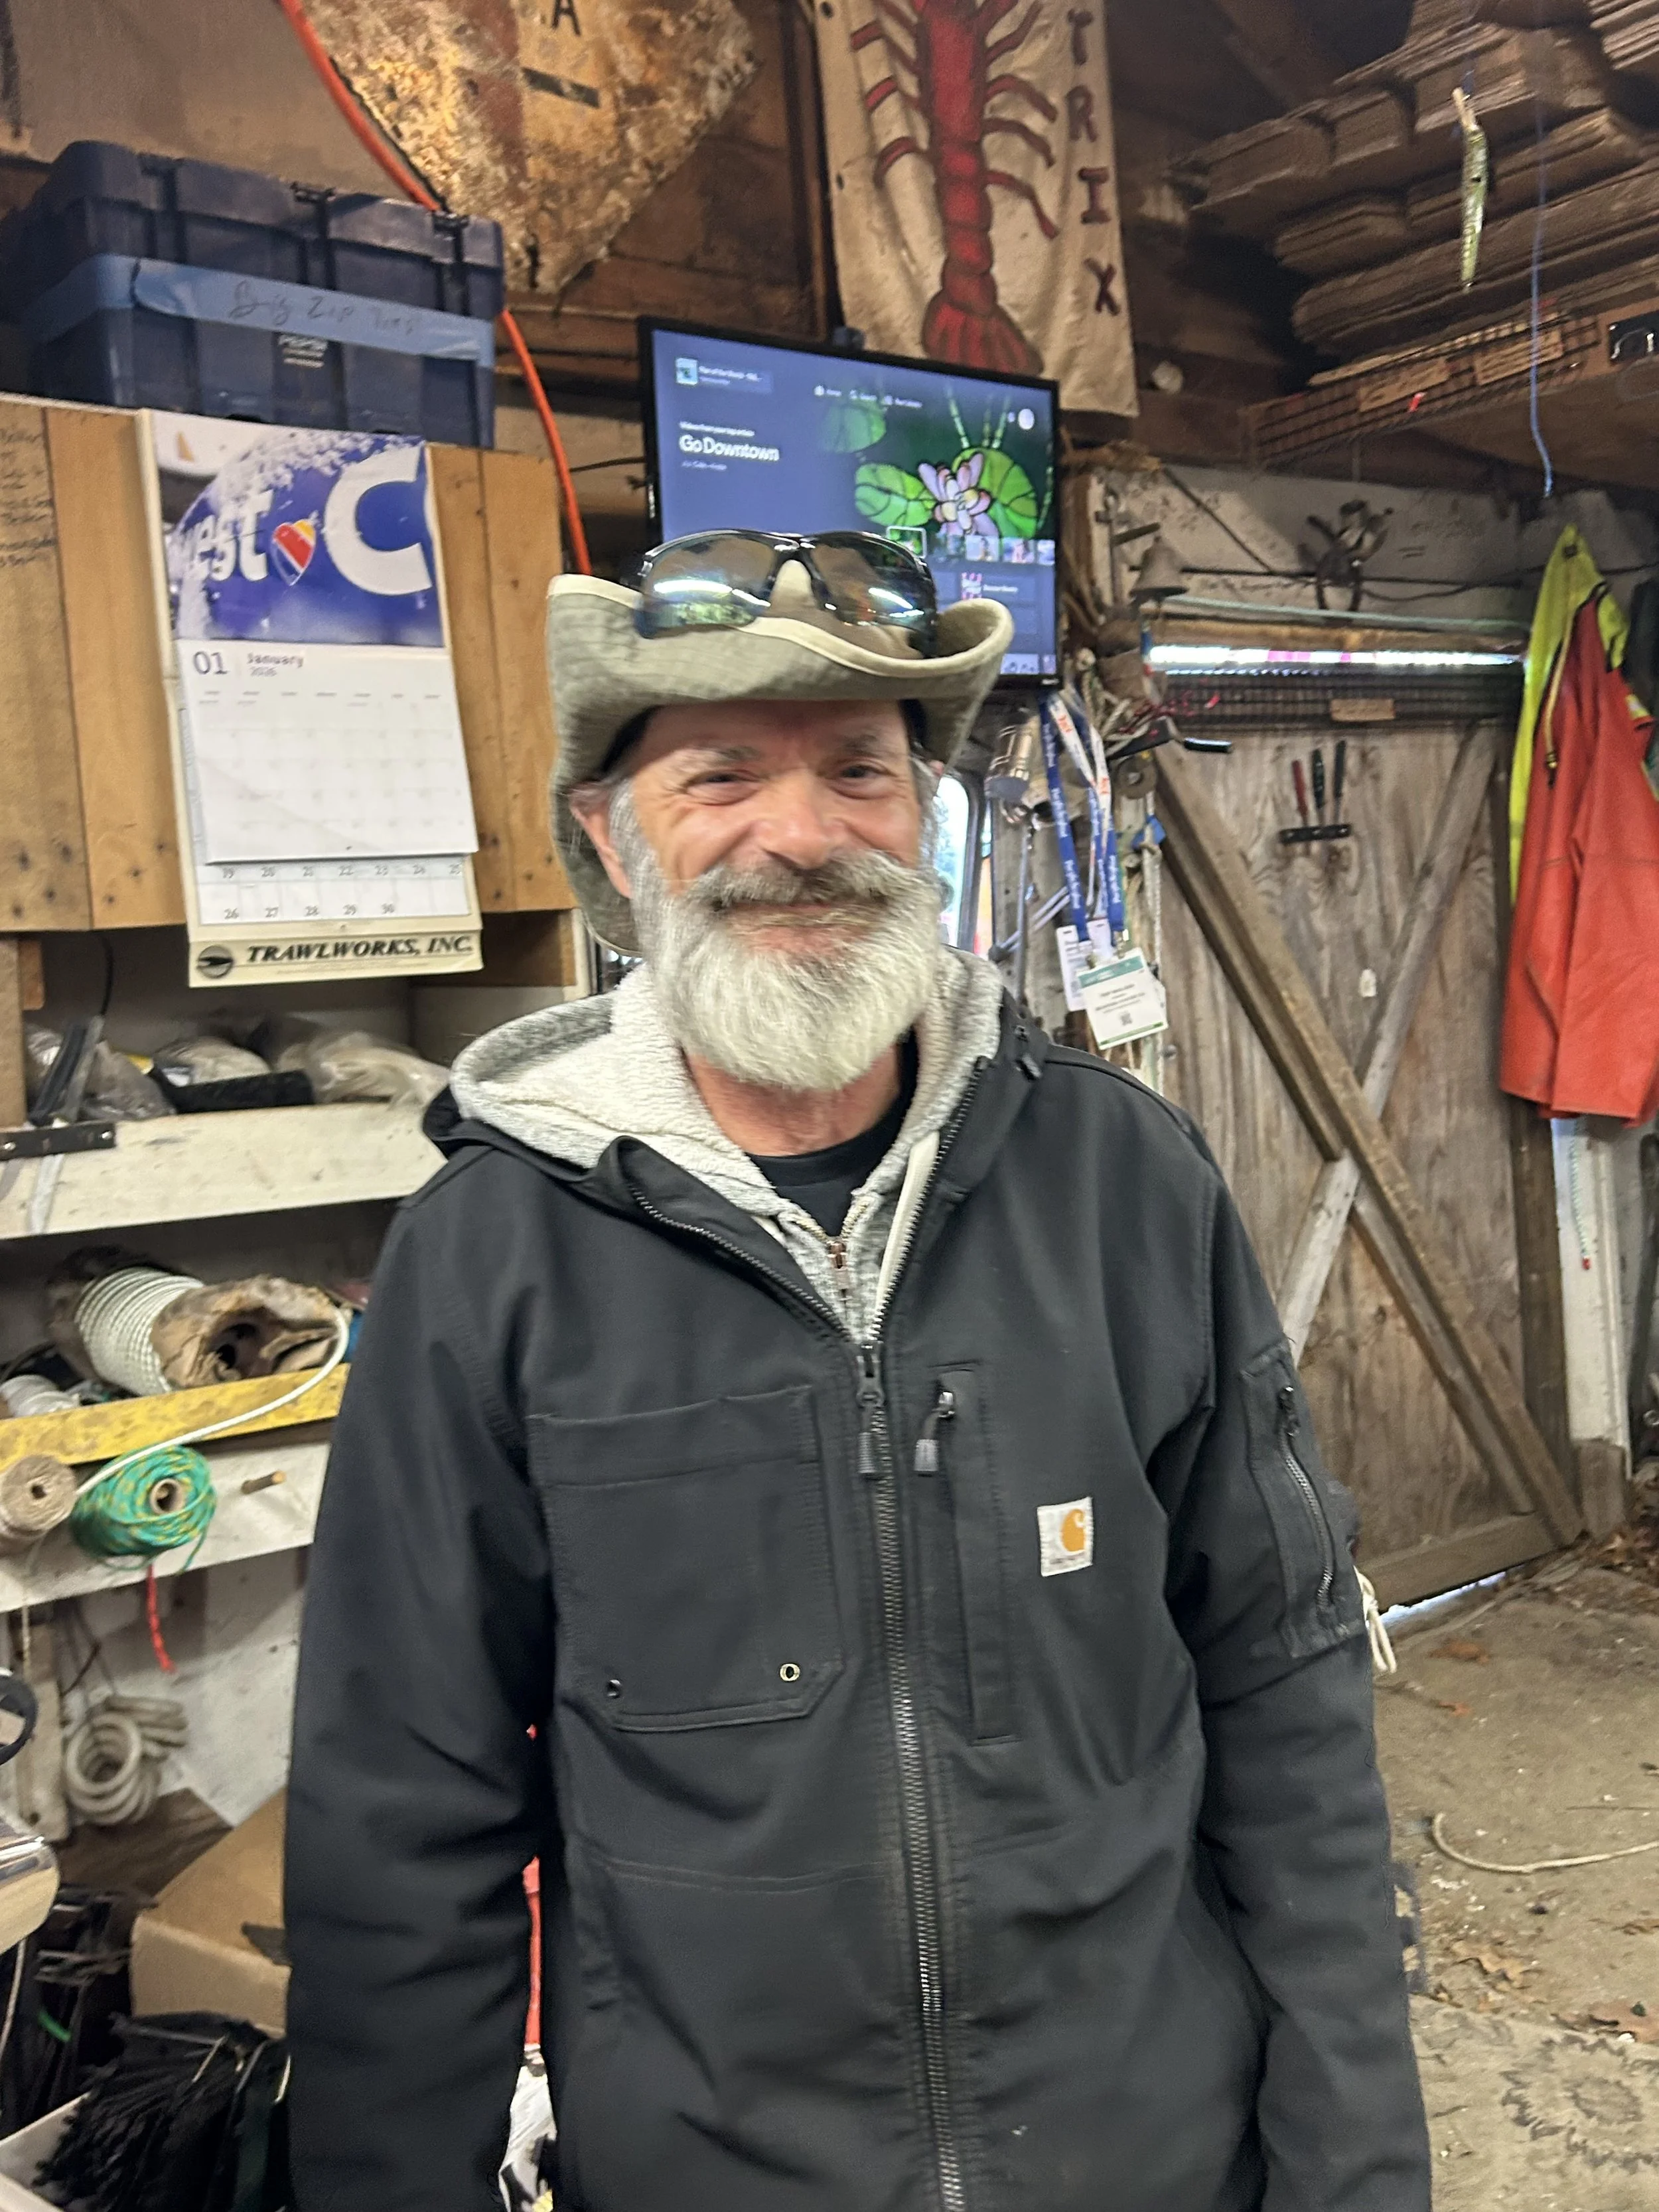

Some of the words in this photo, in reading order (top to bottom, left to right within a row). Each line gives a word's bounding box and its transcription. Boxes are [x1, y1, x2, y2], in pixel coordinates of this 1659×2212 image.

[551, 0, 581, 36] A
[192, 651, 228, 675] 01
[248, 652, 304, 668] January
[338, 865, 354, 876] 22
[375, 865, 389, 876] 23
[224, 907, 240, 920] 26
[265, 907, 279, 918] 27
[305, 905, 320, 917] 28
[342, 904, 357, 916] 29
[248, 938, 421, 962] TRAWLWORKS,
[427, 936, 474, 954] INC.
